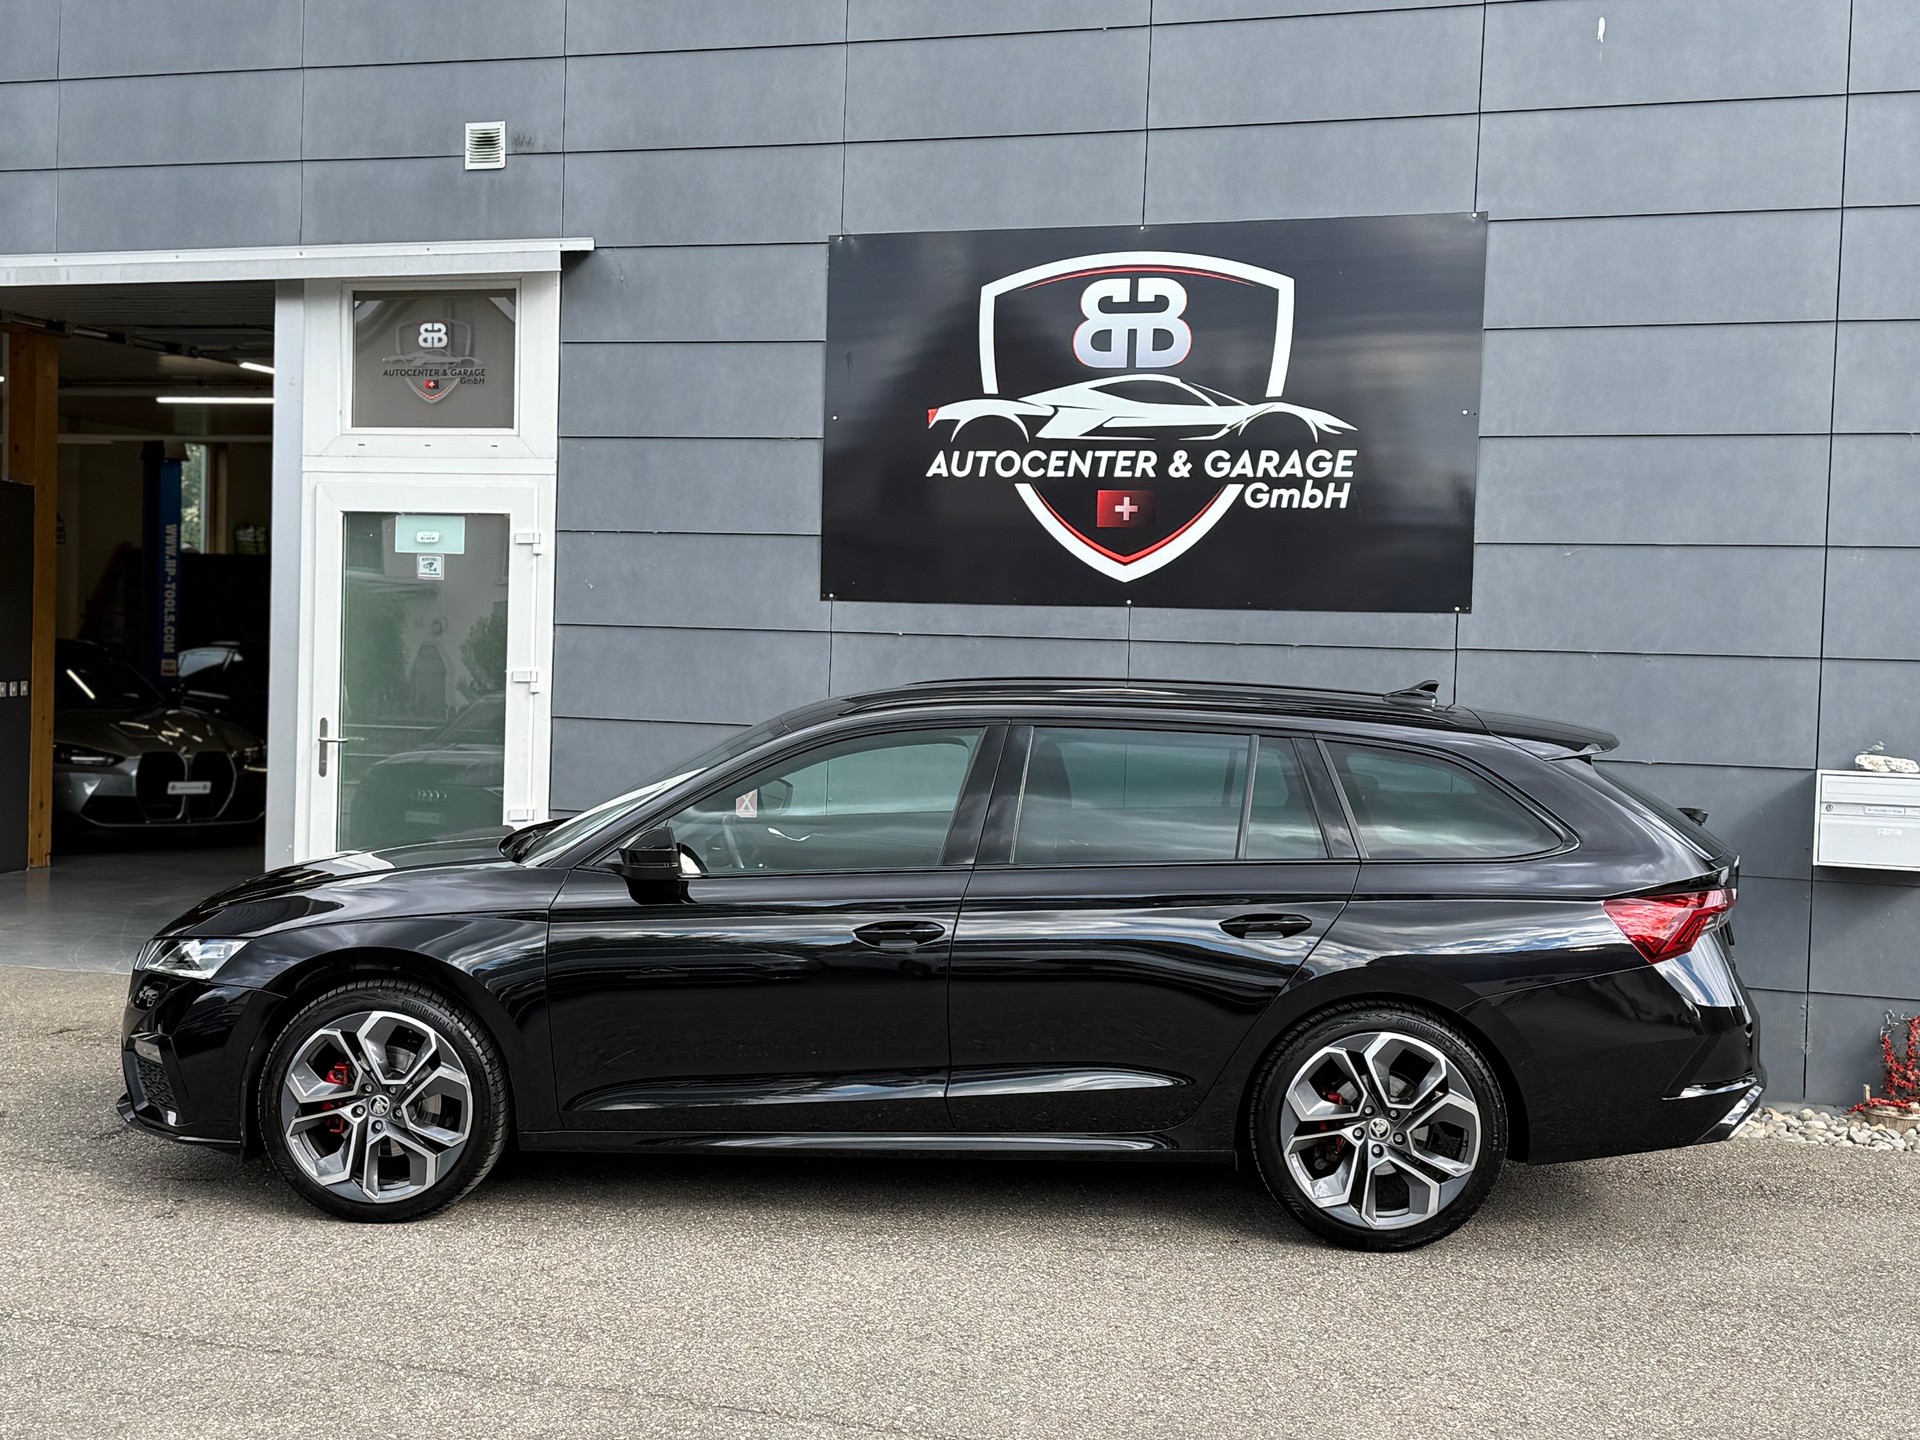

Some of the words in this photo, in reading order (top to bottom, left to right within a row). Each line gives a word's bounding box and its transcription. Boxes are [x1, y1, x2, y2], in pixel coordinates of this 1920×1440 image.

[383, 369, 440, 377] AUTOCENTER
[450, 369, 486, 377] GARAGE
[460, 377, 485, 385] GmbH
[926, 449, 1156, 479] AUTOCENTER
[1168, 451, 1192, 478] &
[1204, 449, 1358, 479] GARAGE
[1244, 481, 1351, 511] GmbH
[163, 523, 178, 653] WWW.RP-TOOLS.COM
[402, 1000, 450, 1029] Continental
